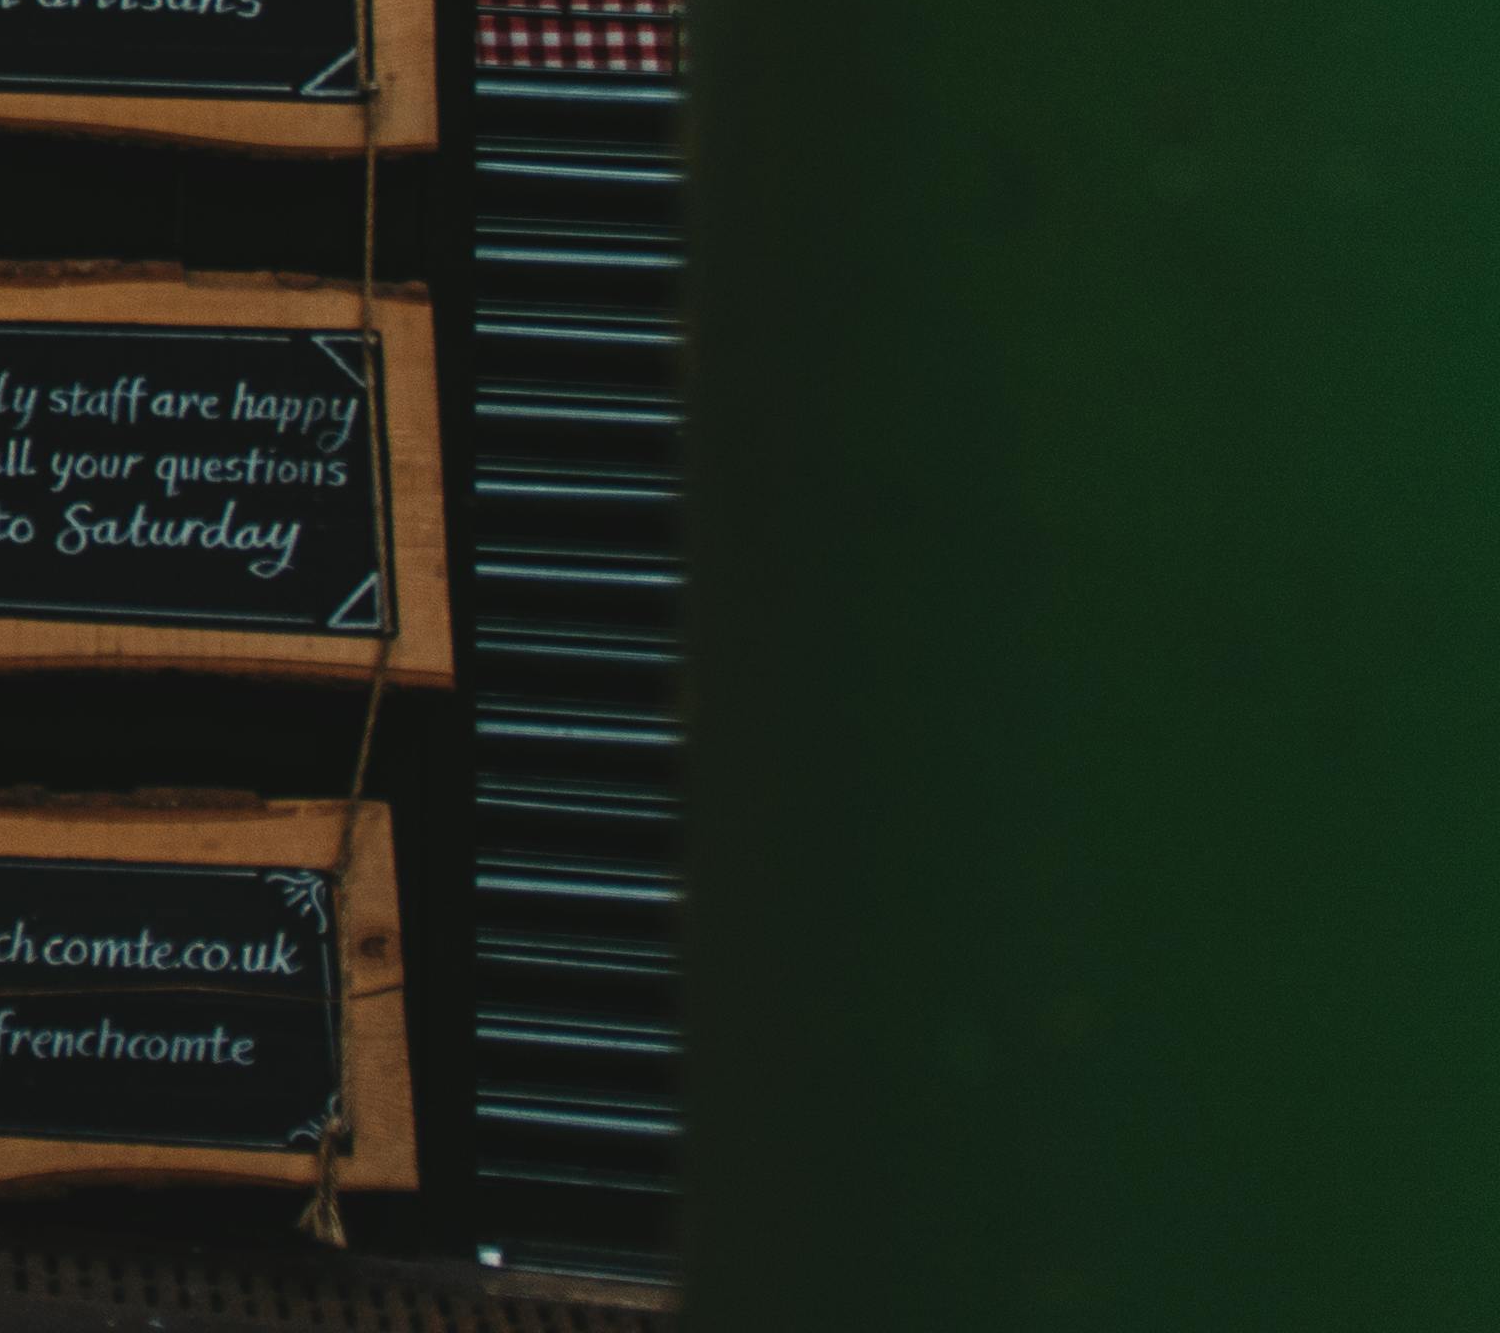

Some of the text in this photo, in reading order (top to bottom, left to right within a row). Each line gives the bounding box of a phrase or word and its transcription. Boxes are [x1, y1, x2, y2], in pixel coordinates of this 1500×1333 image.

[48, 377, 147, 424] staff
[151, 390, 219, 421] are
[230, 383, 359, 453] happy
[50, 450, 142, 492] your
[155, 449, 349, 496] questions
[56, 501, 300, 578] Saturday
